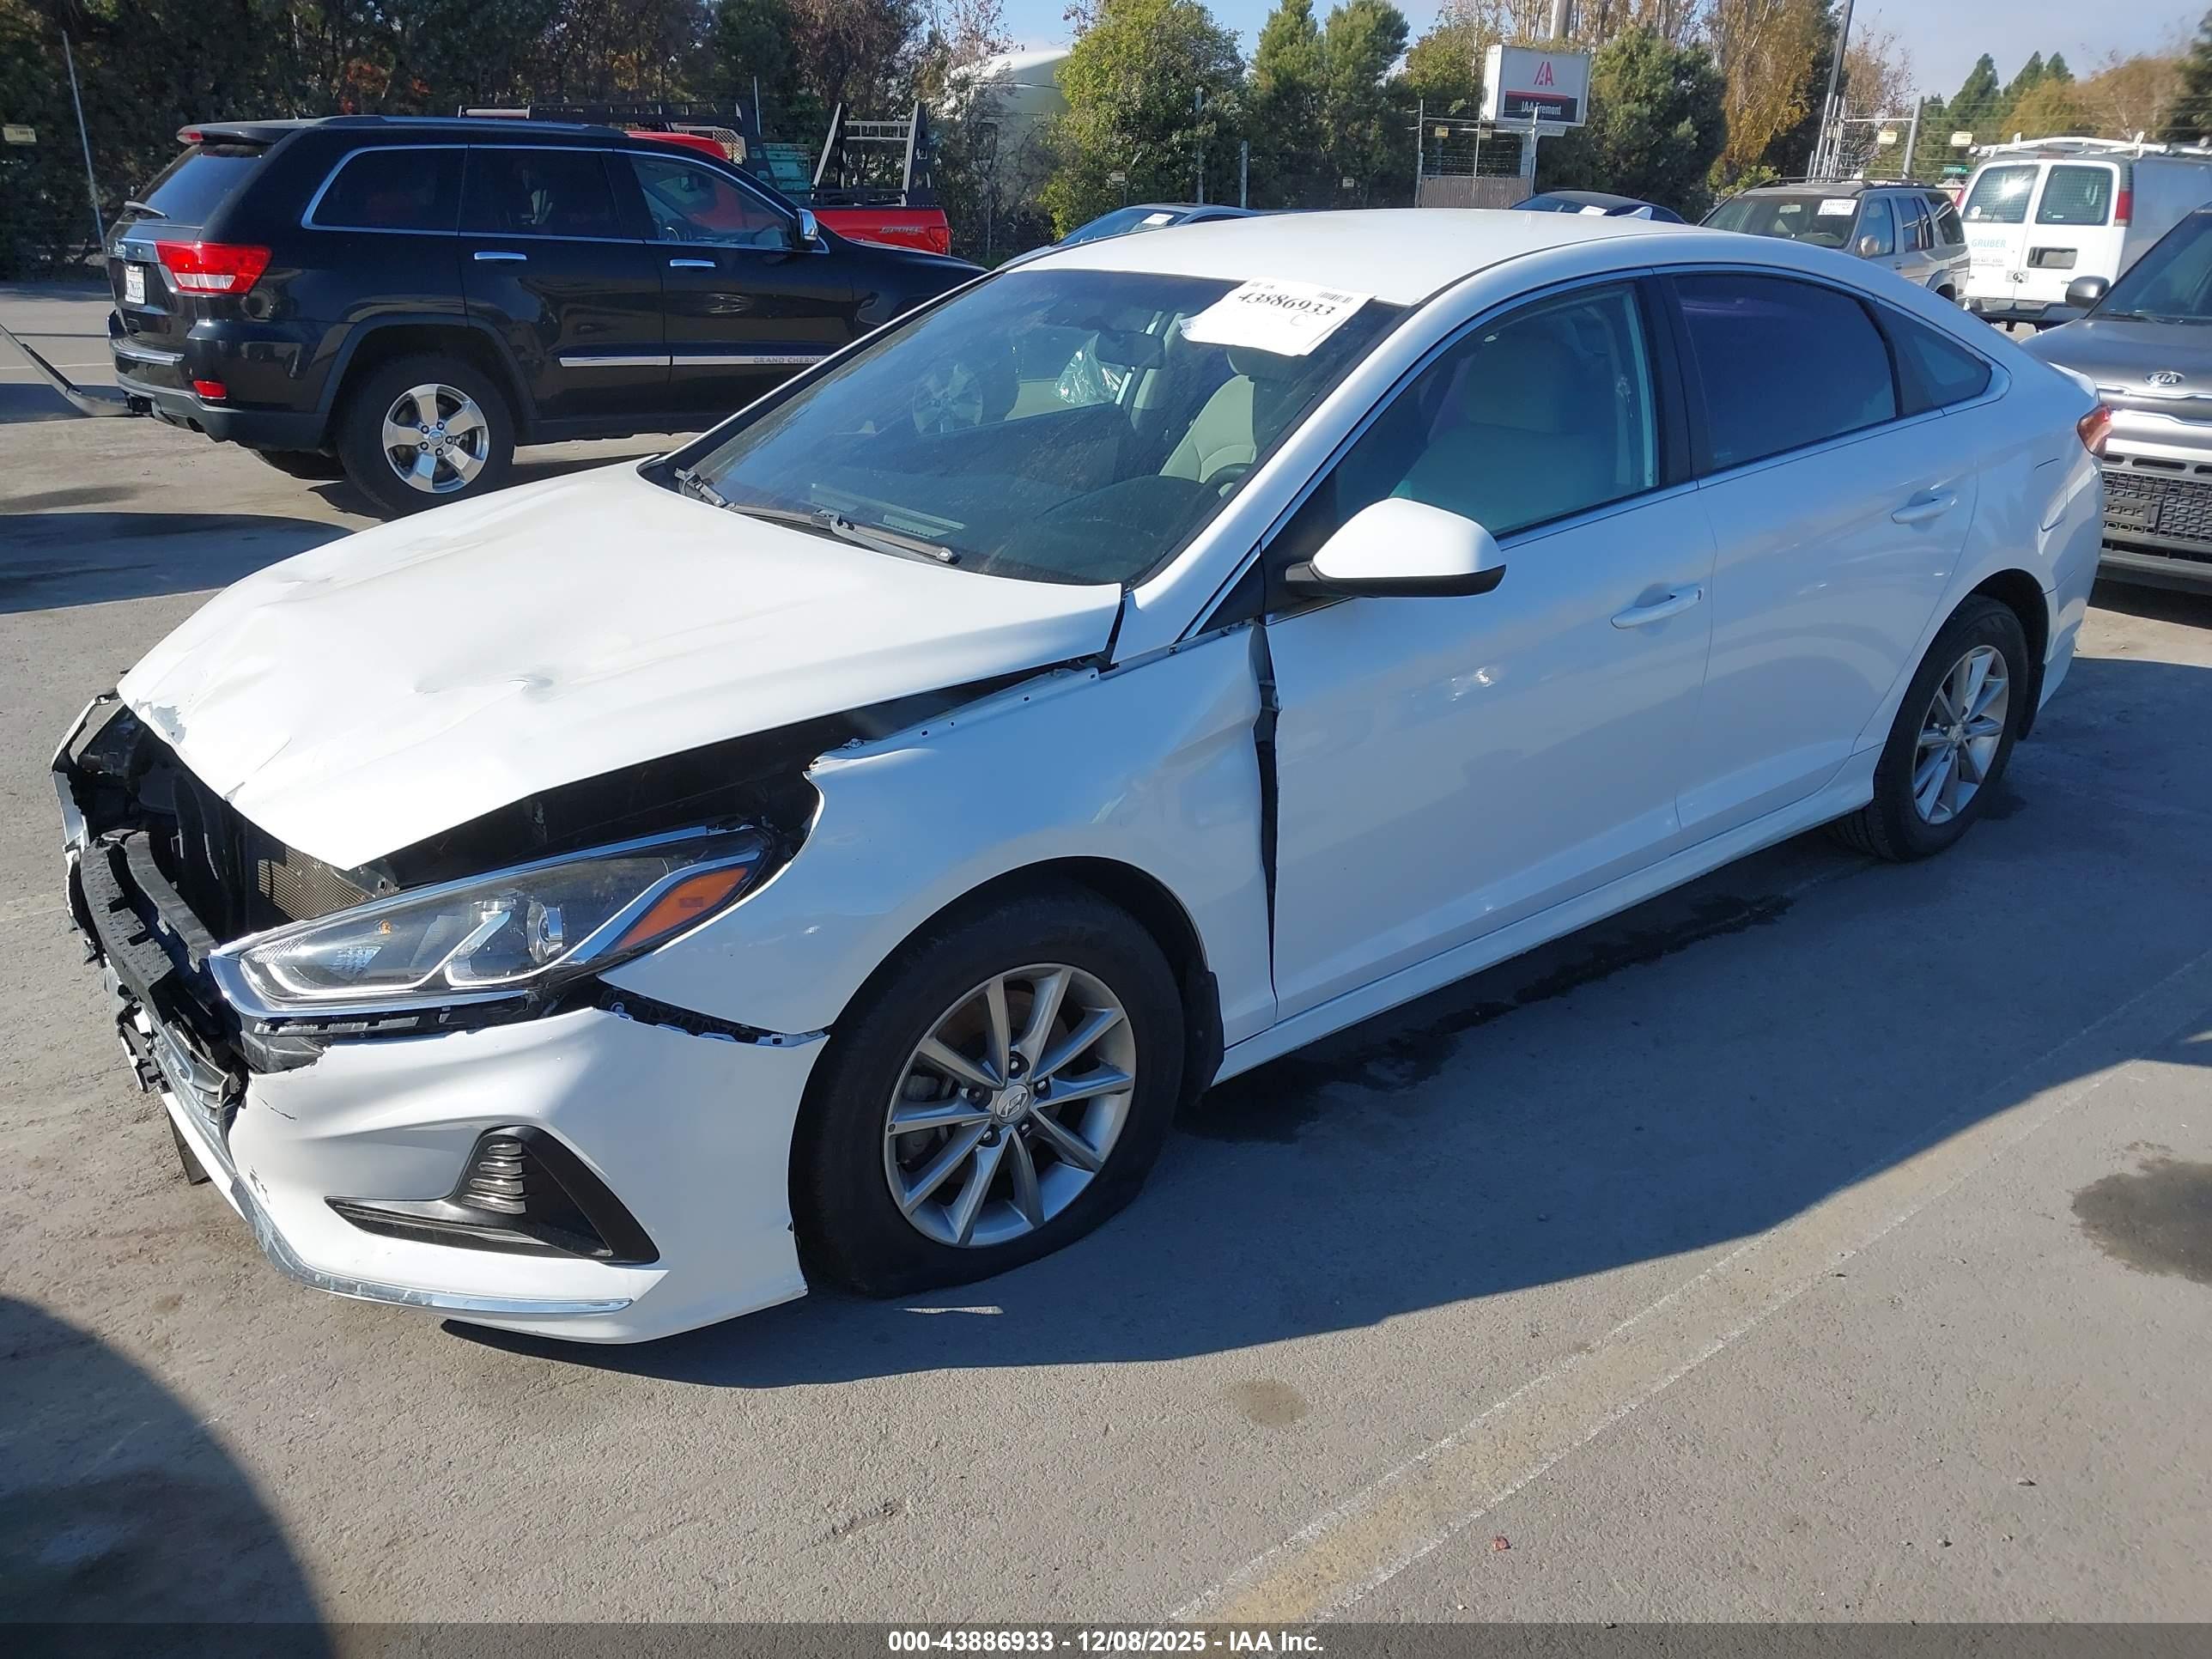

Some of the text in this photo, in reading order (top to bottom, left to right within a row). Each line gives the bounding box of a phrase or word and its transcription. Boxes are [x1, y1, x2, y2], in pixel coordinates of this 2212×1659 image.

[1521, 100, 1561, 115] IAA Fremont
[1971, 239, 2007, 247] GRUBER
[1238, 292, 1337, 316] 43886933
[2150, 374, 2177, 384] KIA
